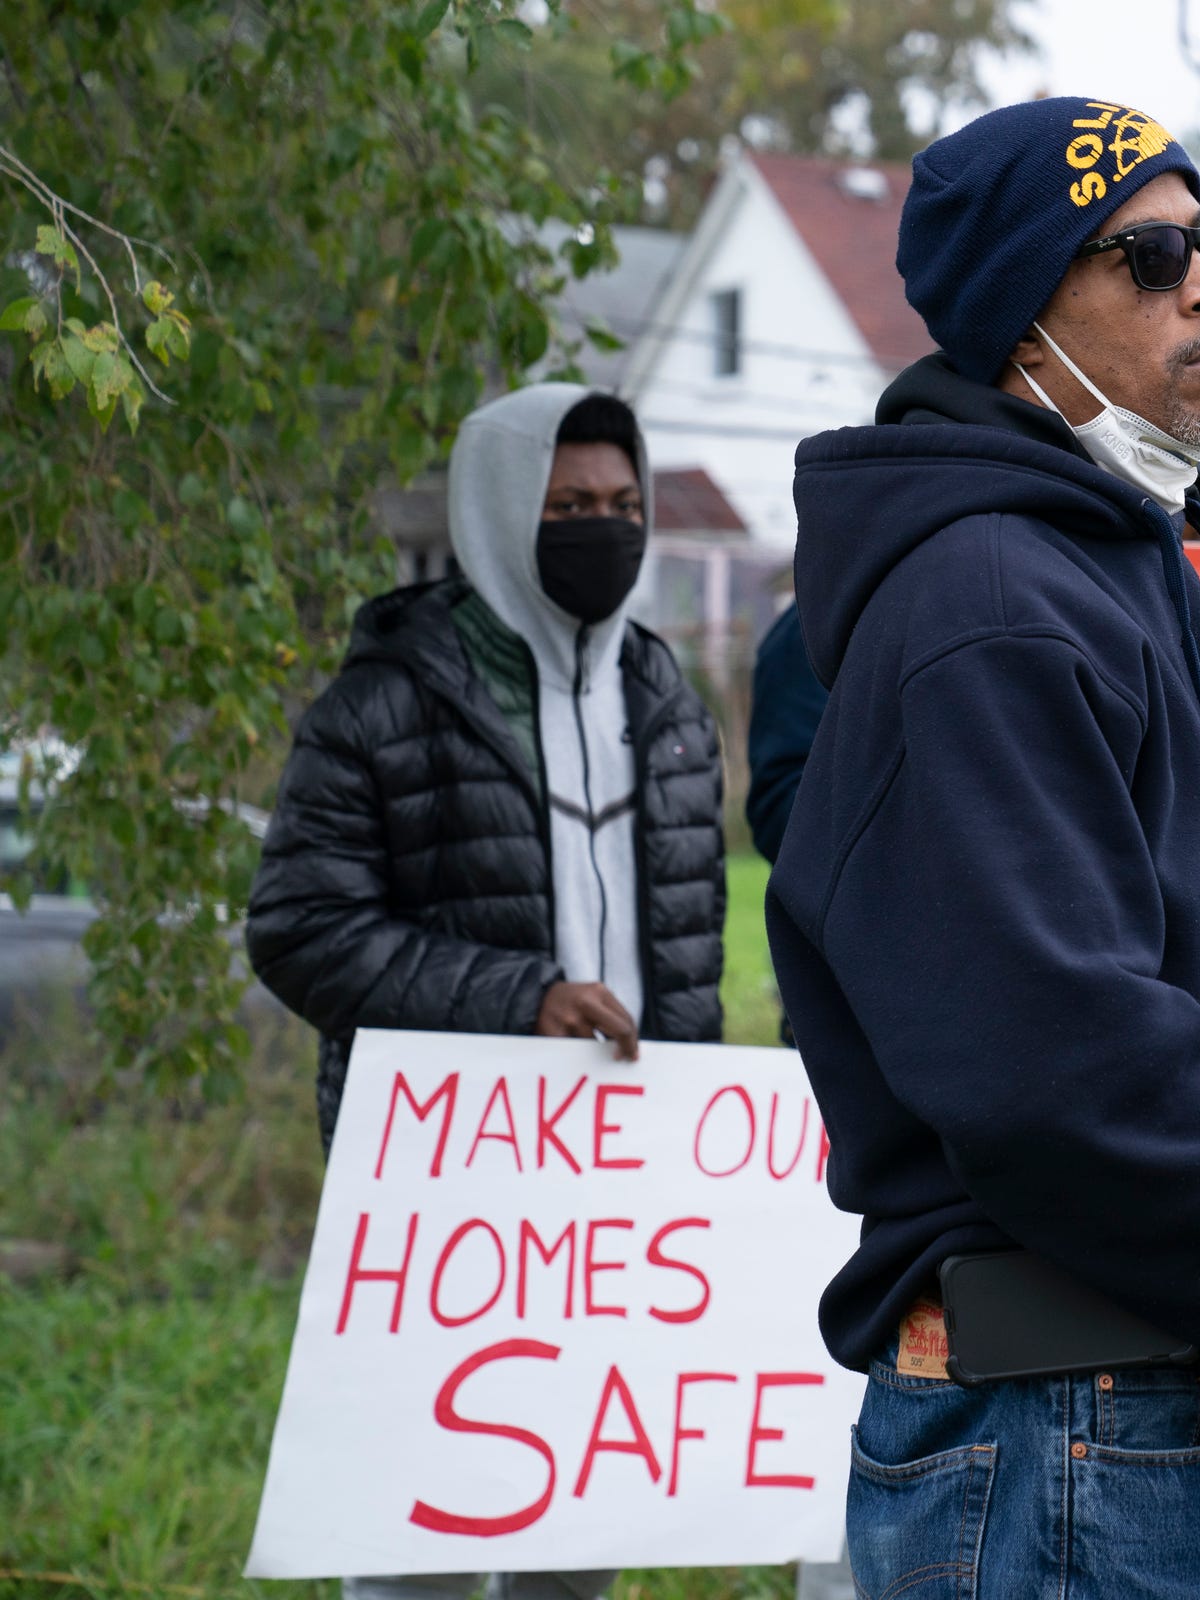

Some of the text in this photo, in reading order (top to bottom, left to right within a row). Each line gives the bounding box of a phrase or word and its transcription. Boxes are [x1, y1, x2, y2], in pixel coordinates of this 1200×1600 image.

[374, 1071, 646, 1180] MAKE
[335, 1212, 712, 1335] HOMES
[408, 1338, 826, 1538] SAFE
